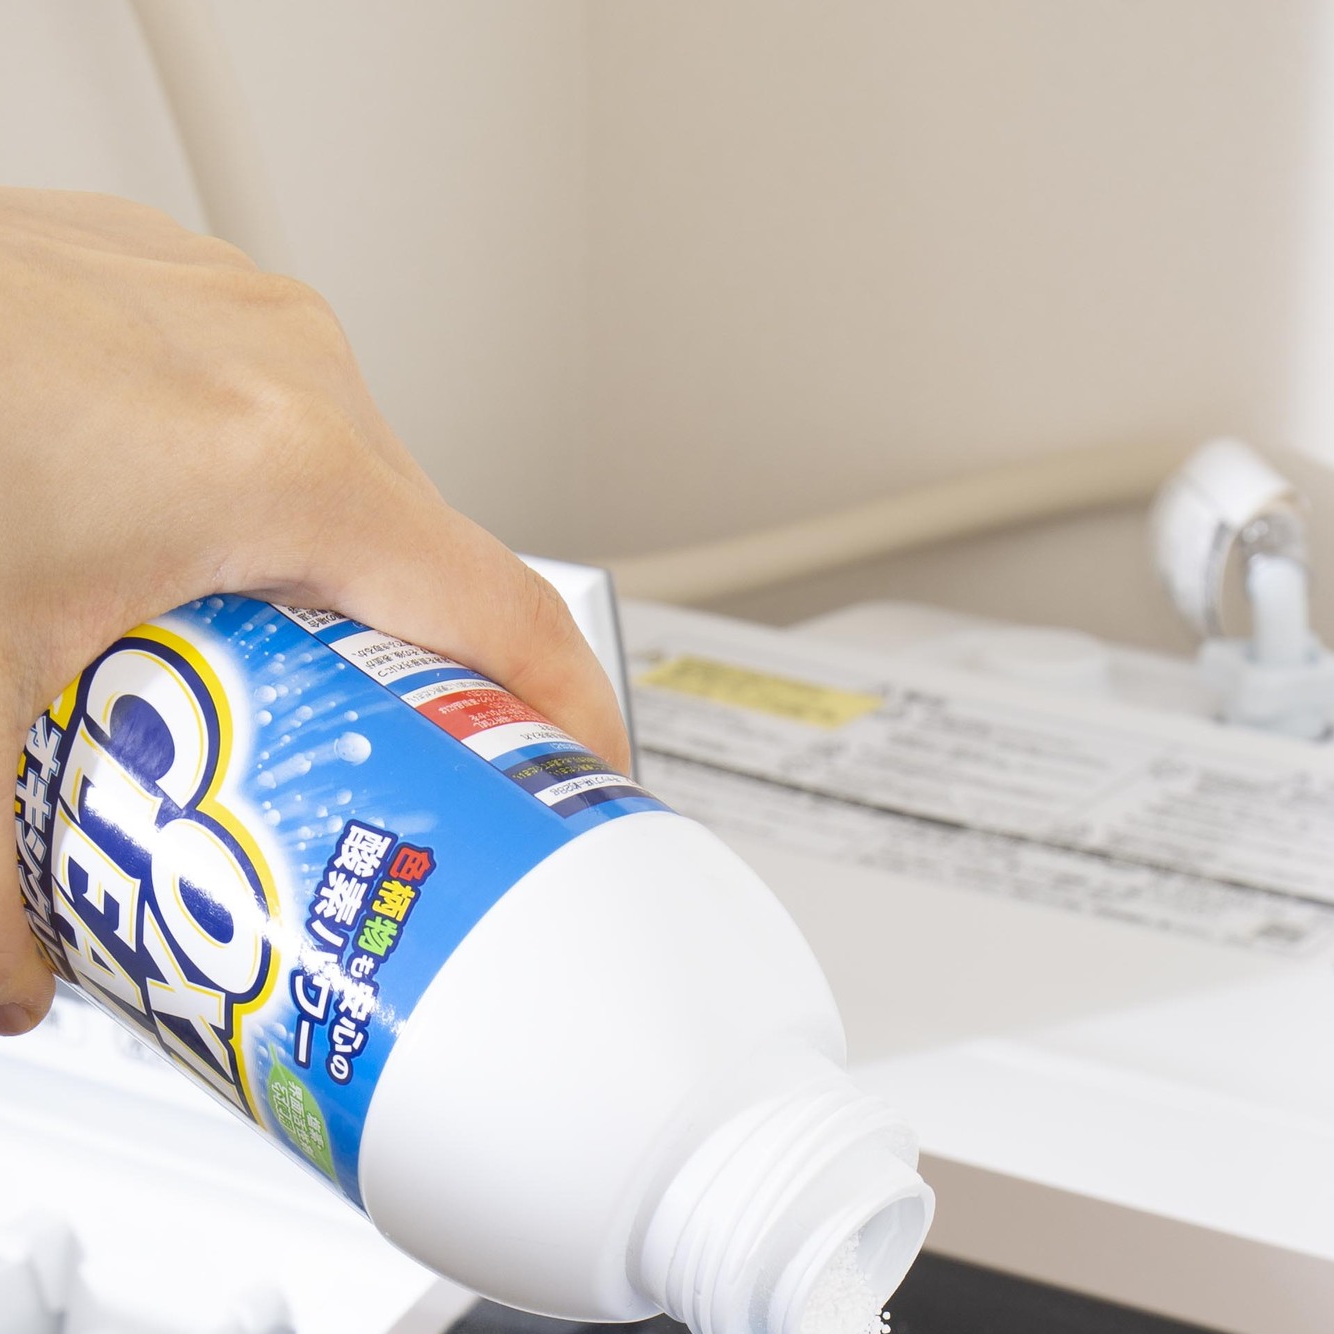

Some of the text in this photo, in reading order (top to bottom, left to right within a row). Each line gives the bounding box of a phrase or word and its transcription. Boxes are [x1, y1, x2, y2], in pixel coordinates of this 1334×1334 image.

[330, 847, 431, 1079] 色柄物も安心の
